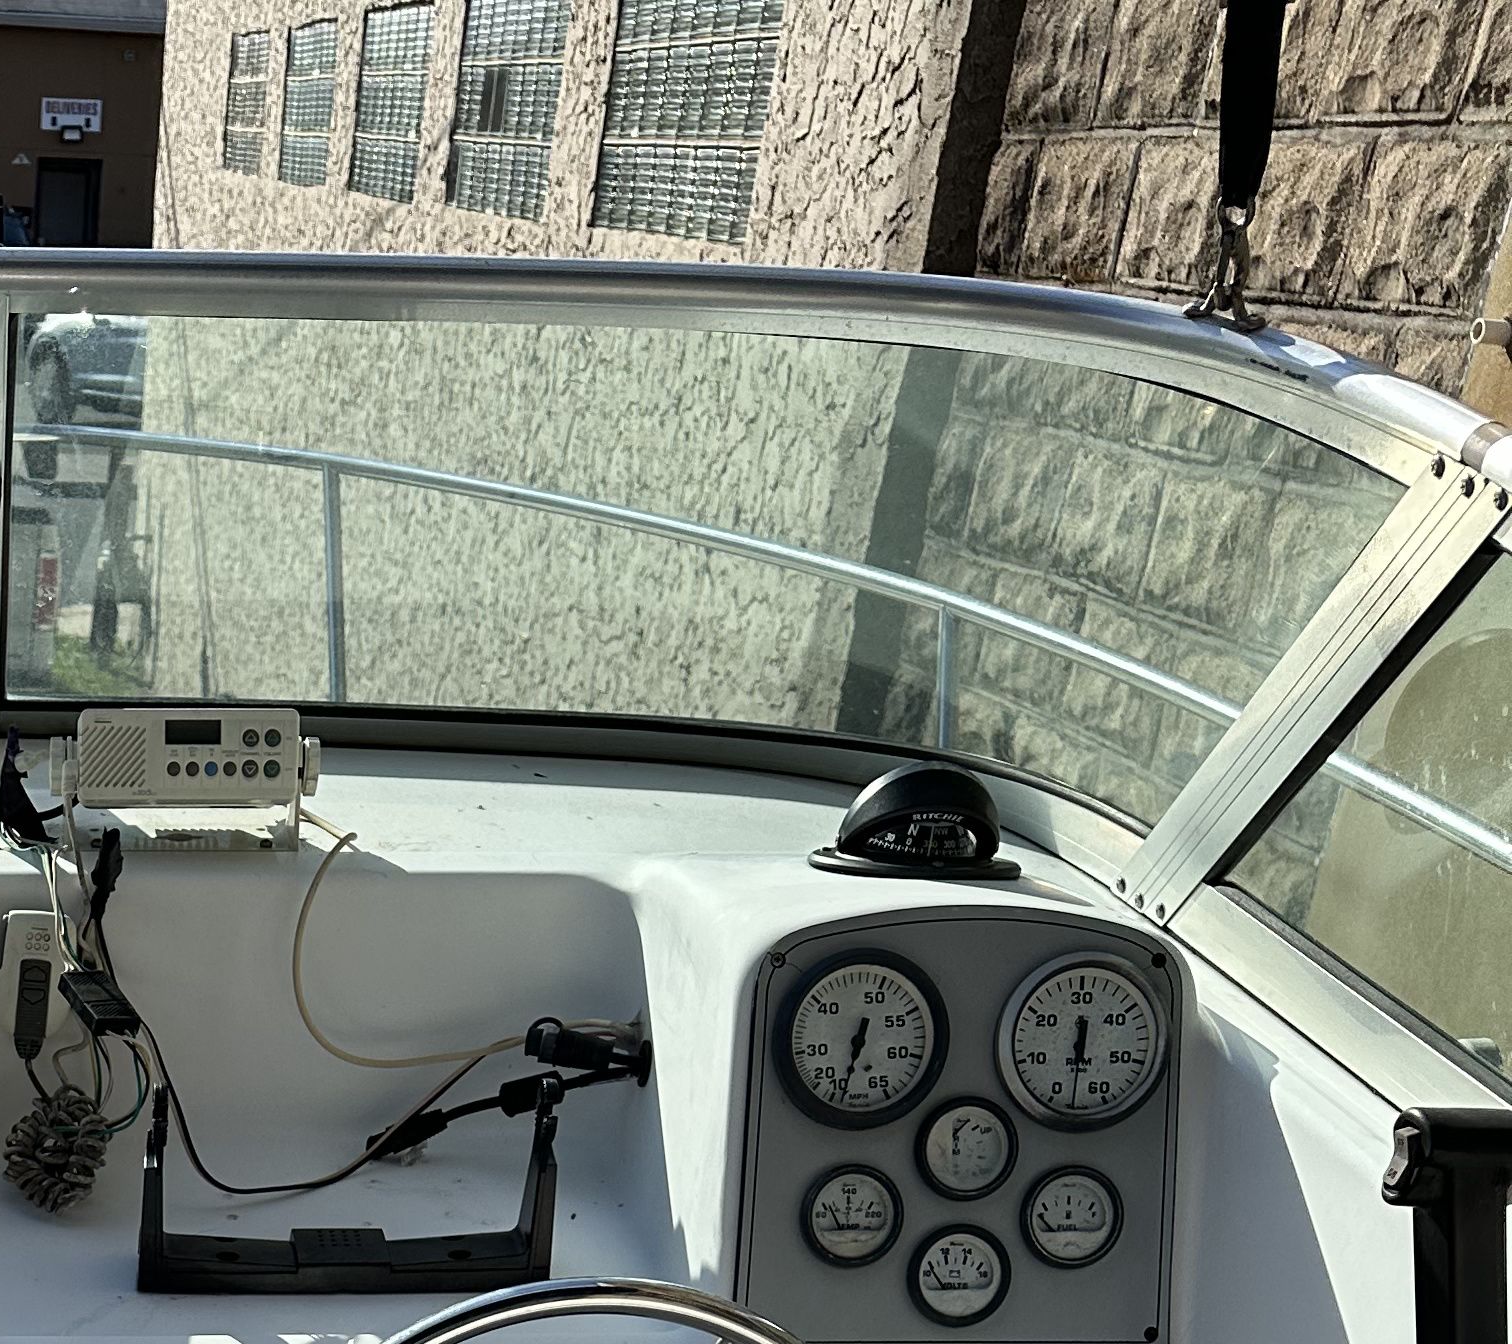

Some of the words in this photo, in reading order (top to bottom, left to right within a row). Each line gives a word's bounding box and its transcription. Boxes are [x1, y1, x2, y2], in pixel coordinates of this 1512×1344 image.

[45, 100, 98, 115] DELIVERIES
[912, 812, 965, 822] RITCHIE
[907, 823, 920, 836] N
[863, 991, 886, 1005] 50
[1070, 991, 1094, 1005] 30
[817, 1002, 839, 1015] 40
[884, 1015, 906, 1028] 55
[1035, 1013, 1058, 1027] 20
[1103, 1013, 1126, 1026] 40
[806, 1043, 828, 1056] 30
[887, 1046, 909, 1059] 60
[1027, 1051, 1047, 1065] 10
[1066, 1057, 1092, 1066] RM
[1109, 1050, 1132, 1064] 50
[814, 1066, 836, 1079] 20
[829, 1078, 848, 1091] 10
[868, 1075, 889, 1089] 65
[1051, 1081, 1063, 1095] 0
[1087, 1081, 1110, 1095] 60
[848, 1093, 869, 1101] MPH
[980, 1126, 993, 1135] UP
[841, 1187, 857, 1195] 140
[940, 1247, 950, 1256] 12
[961, 1247, 973, 1256] 14
